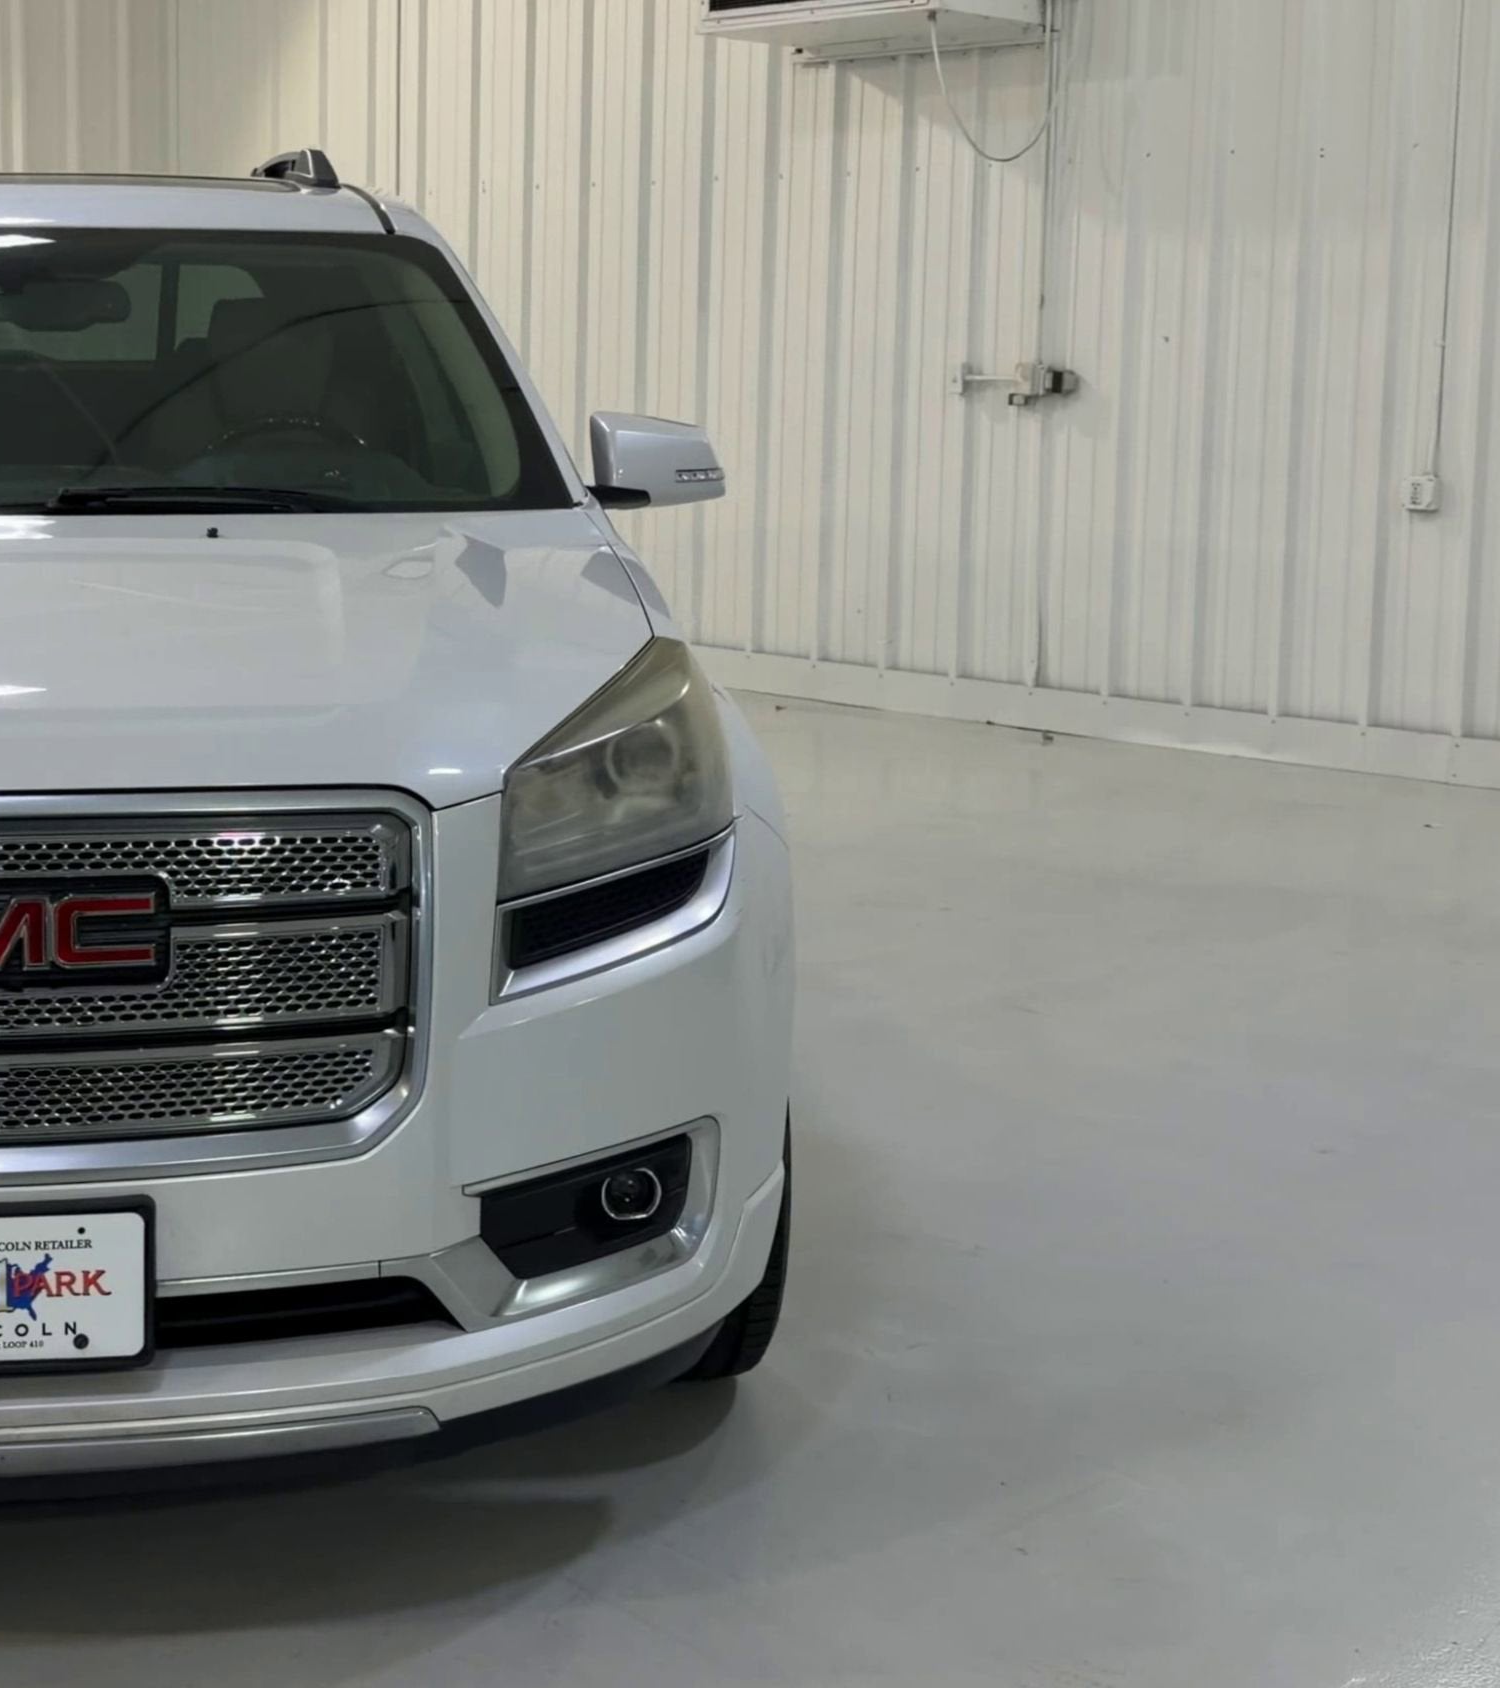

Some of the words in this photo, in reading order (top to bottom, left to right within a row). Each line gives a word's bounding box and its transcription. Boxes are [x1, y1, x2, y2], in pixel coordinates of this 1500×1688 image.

[34, 1239, 93, 1251] RETAILER
[12, 1269, 112, 1298] PARK
[3, 1340, 27, 1349] LOOP
